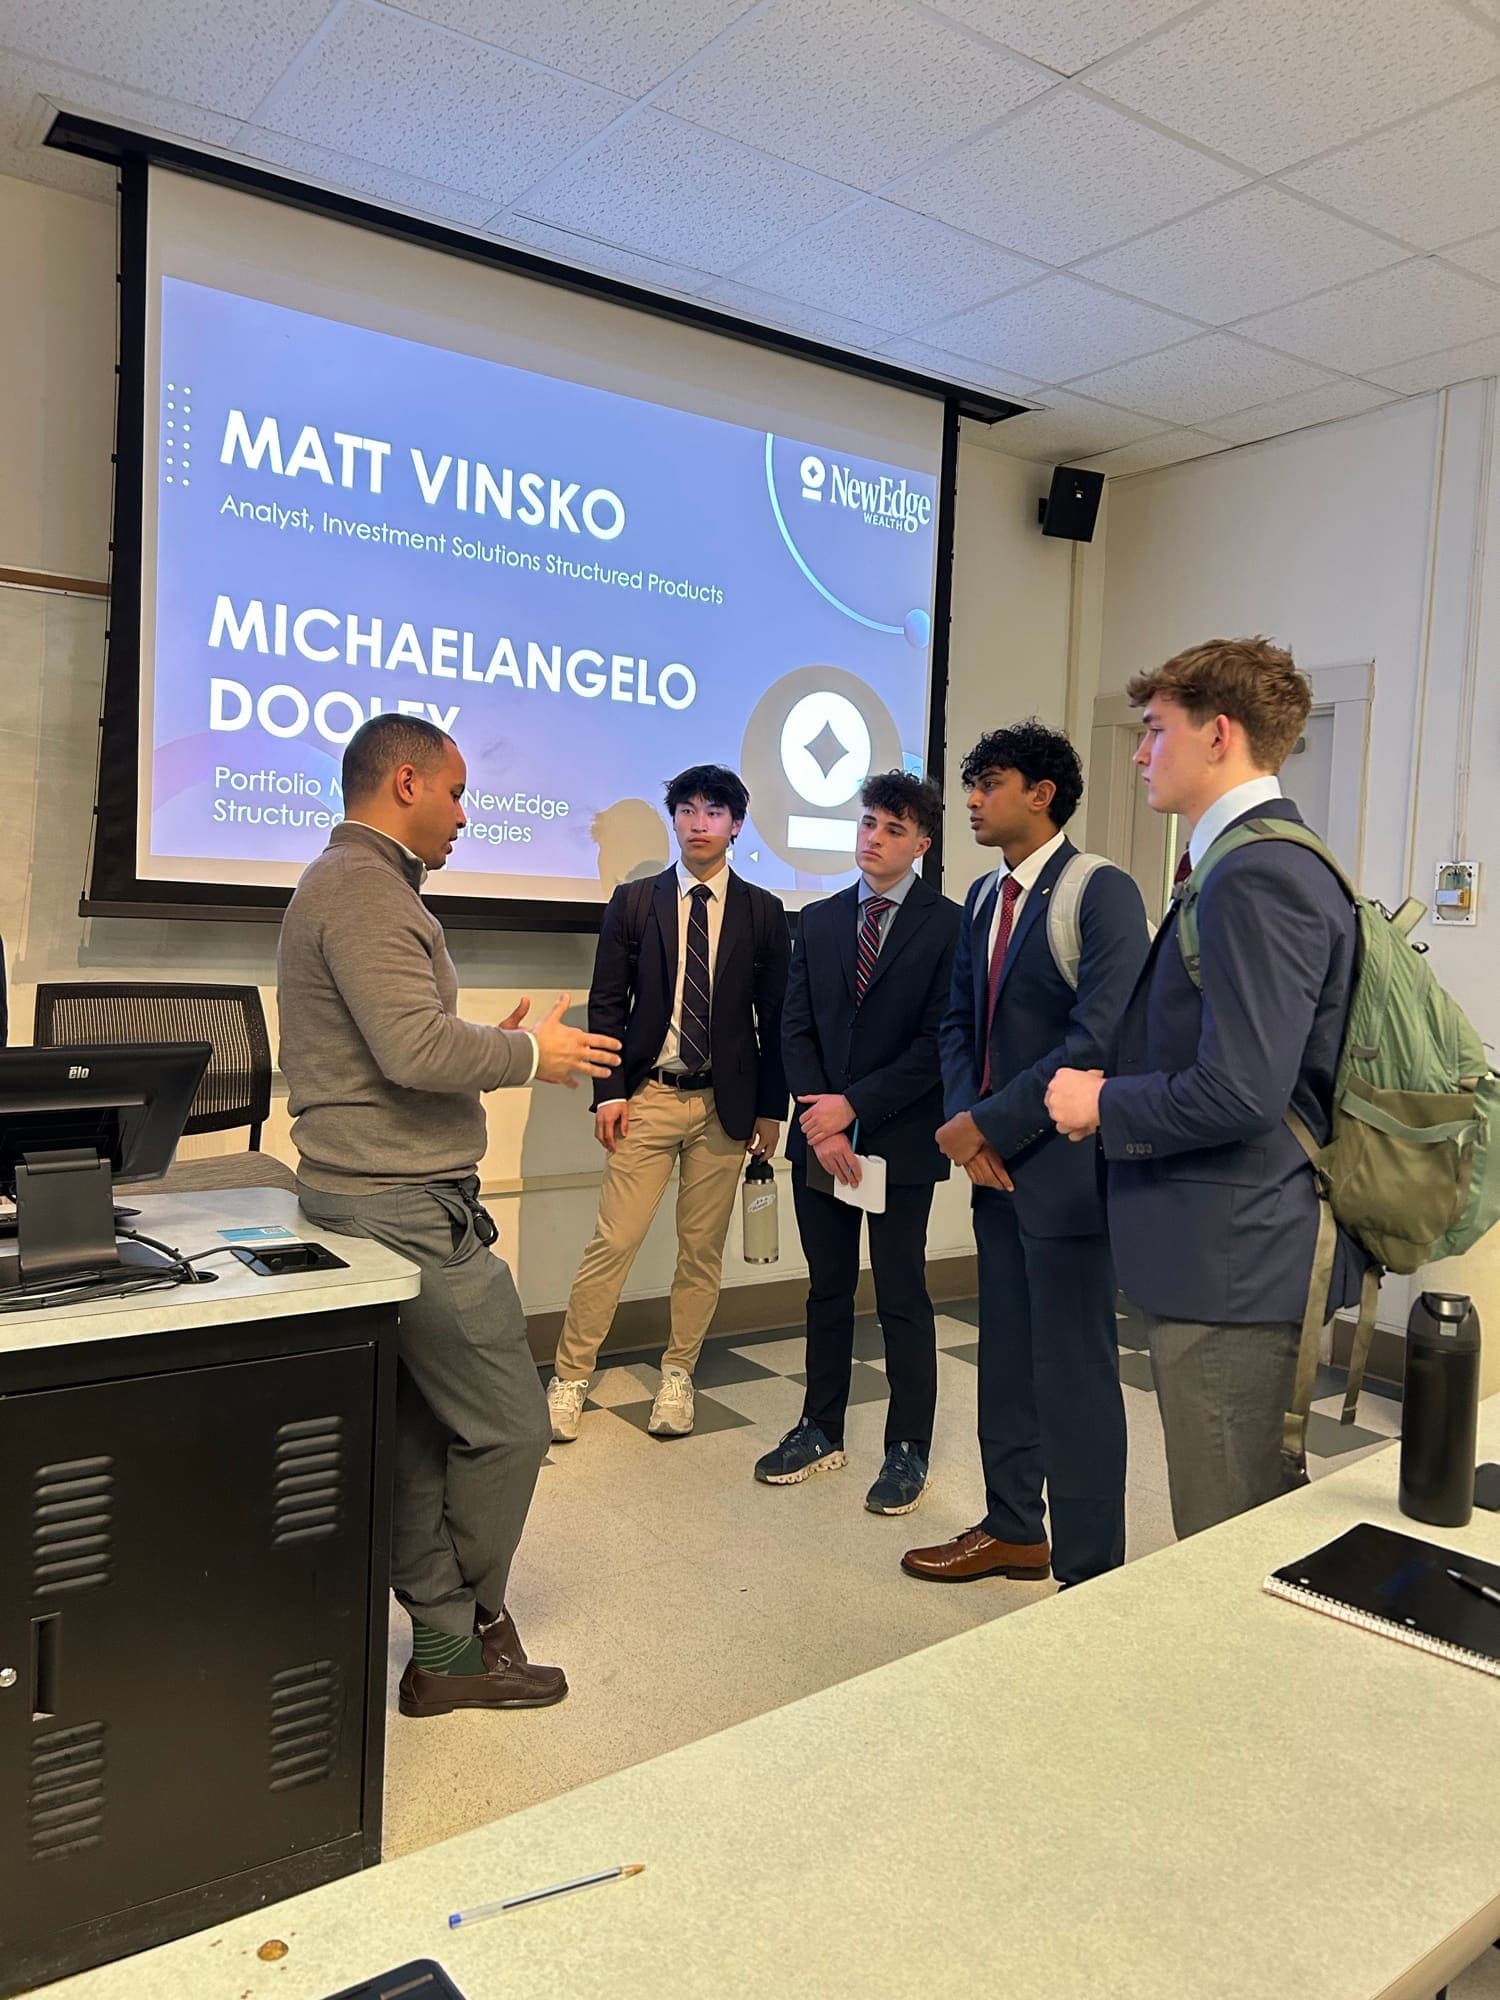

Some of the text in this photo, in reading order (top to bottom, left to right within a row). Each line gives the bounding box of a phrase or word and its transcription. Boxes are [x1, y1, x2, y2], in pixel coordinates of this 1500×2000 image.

[220, 409, 625, 540] MATT VINSKO
[830, 464, 931, 533] NewEdge
[220, 495, 724, 604] Analyst, Investment Solutions Structured Products
[863, 512, 903, 531] WEALTH
[208, 595, 697, 710] MICHAELANGELO
[215, 766, 322, 796] Portfolio
[464, 789, 569, 820] NewEdge
